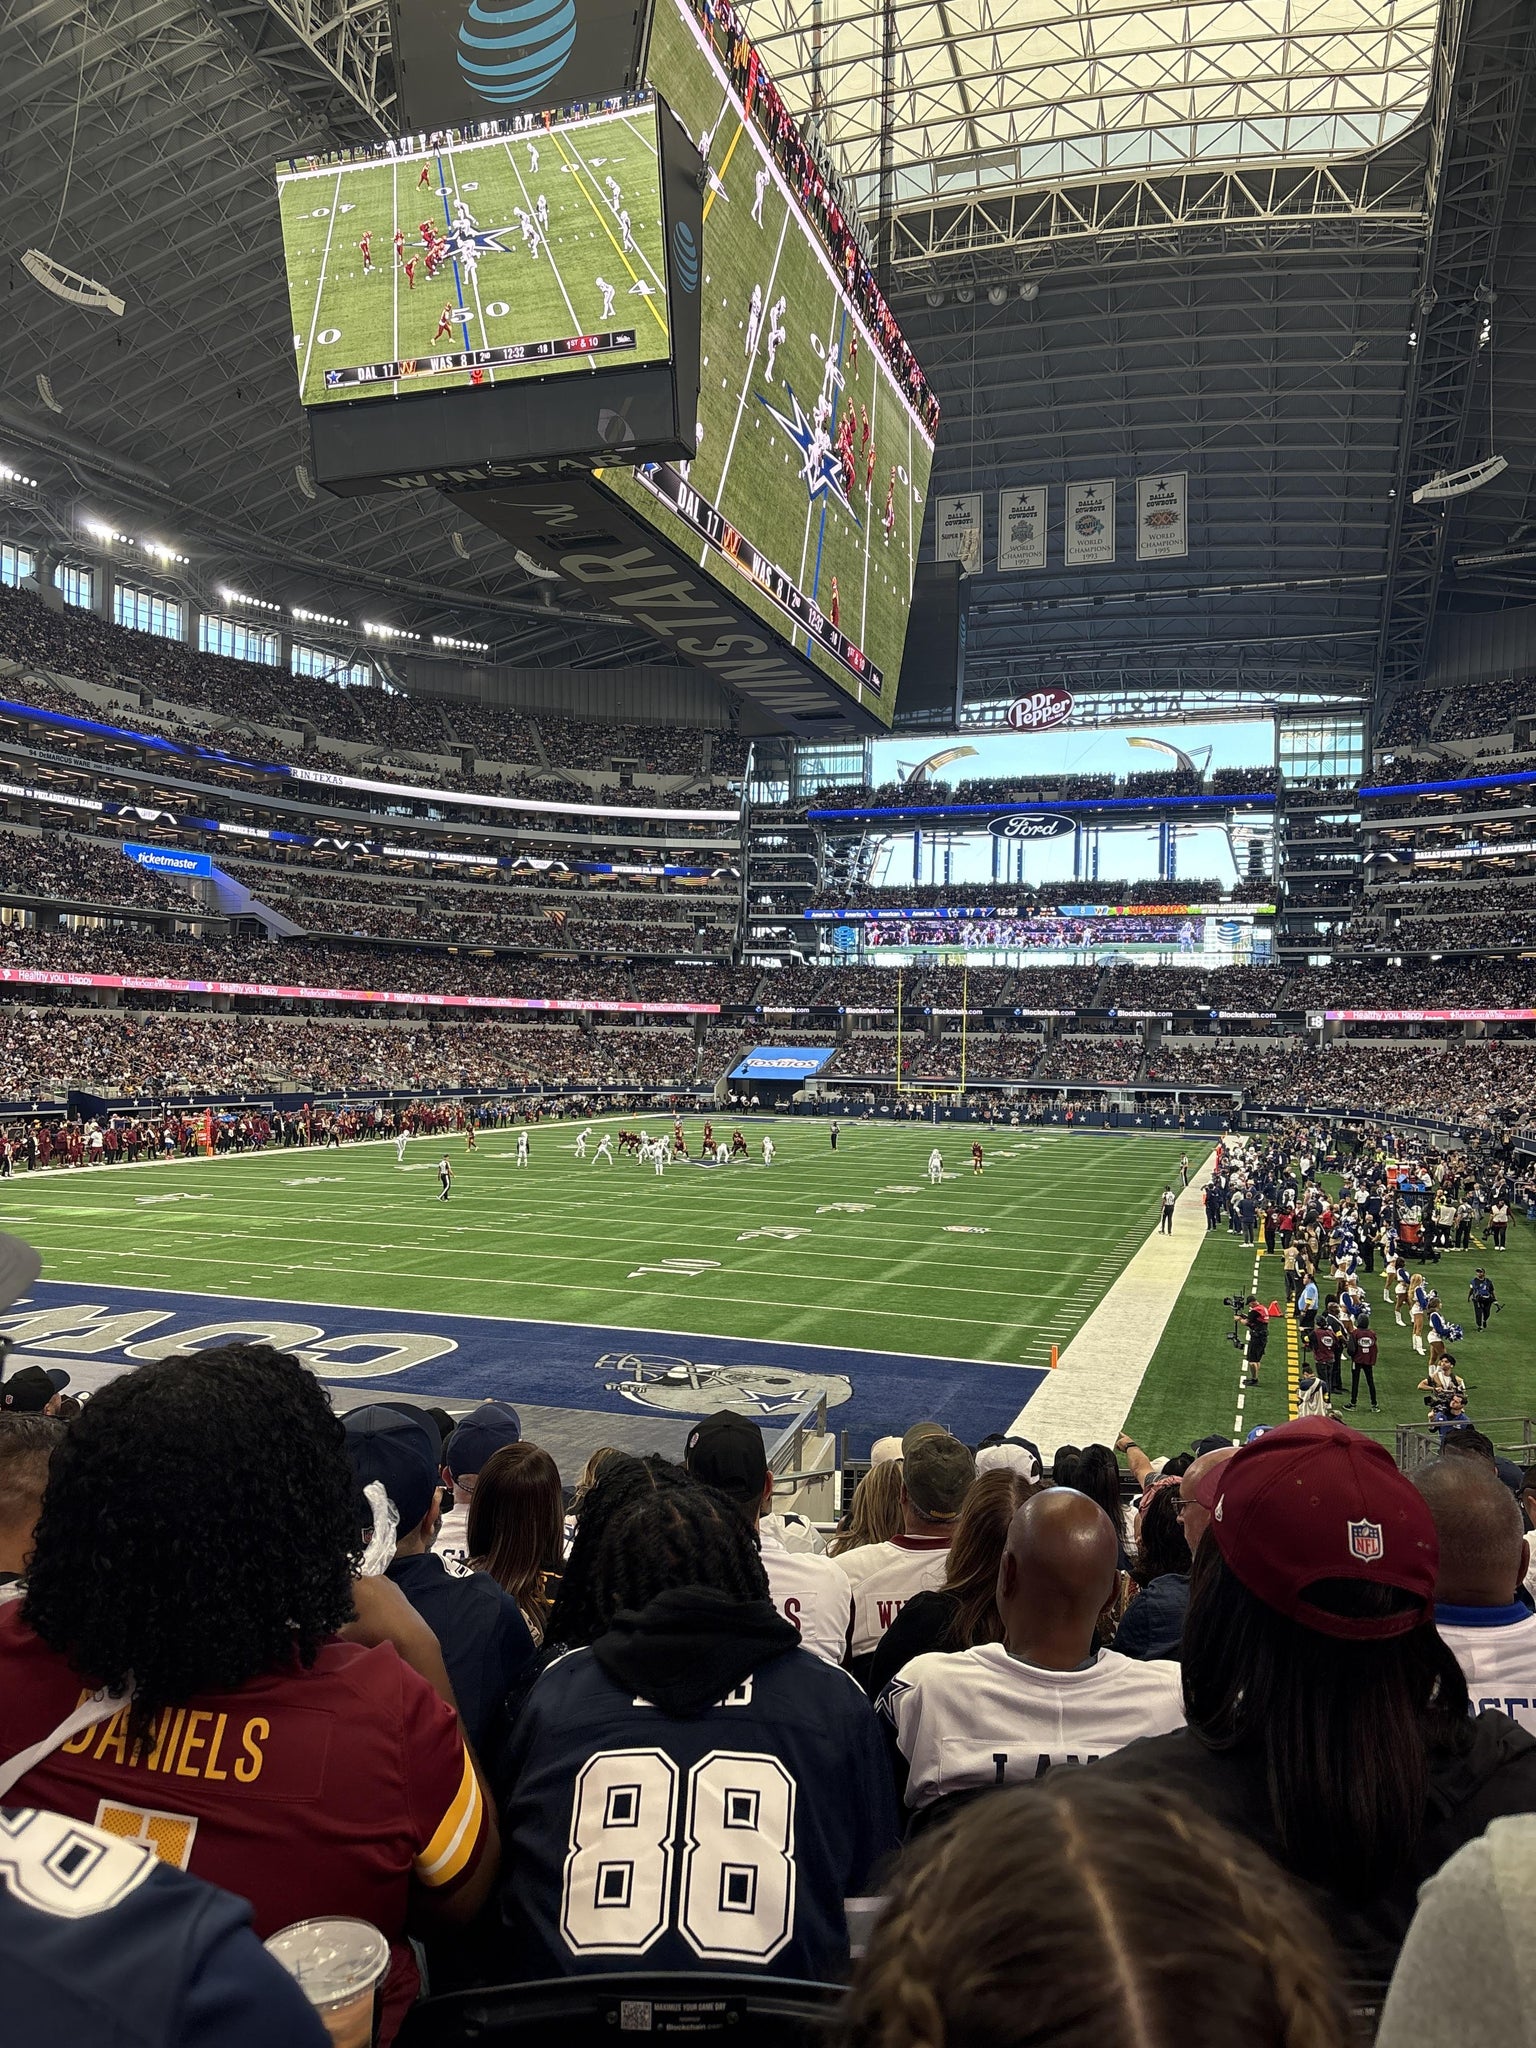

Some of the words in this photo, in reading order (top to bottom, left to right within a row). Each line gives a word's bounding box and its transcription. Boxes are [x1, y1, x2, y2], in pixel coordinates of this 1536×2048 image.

[357, 366, 377, 381] DAL
[382, 364, 394, 377] 17
[430, 355, 453, 369] WAS
[460, 354, 468, 367] 8
[503, 346, 525, 360] 12:32
[566, 339, 578, 350] 1ST
[580, 339, 587, 349] &
[588, 337, 599, 348] 10
[381, 453, 631, 490] WINSTAR
[1149, 492, 1175, 501] DALLAS
[1078, 499, 1103, 507] DALLAS
[1146, 498, 1178, 508] COWBOYS
[1075, 505, 1106, 514] COWBOYS
[947, 511, 971, 519] DALLAS
[1008, 511, 1038, 520] COWBOYS
[944, 518, 973, 527] COWBOYS
[1148, 532, 1176, 540] WORLD
[1009, 544, 1035, 552] WORLD
[1140, 538, 1184, 549] CHAMPIONS
[1069, 545, 1111, 554] CHAMPIONS
[676, 481, 700, 523] DAL
[706, 510, 719, 539] 17
[752, 552, 772, 588] WAS
[776, 577, 784, 599] 8
[808, 607, 824, 634] 12:32
[1001, 551, 1043, 560] CHAMPIONS
[559, 547, 842, 714] WINSTAR
[1031, 693, 1056, 712] Dr
[1015, 698, 1070, 728] Pepper
[73, 759, 91, 768] WARE
[300, 770, 311, 780] IN
[312, 772, 343, 785] TEXAS
[1004, 816, 1059, 836] Ford
[1415, 850, 1441, 860] DALLAS
[1441, 848, 1473, 859] COWBOYS
[1481, 843, 1532, 856] PHILADELPHIA
[137, 851, 198, 870] ticketmaster
[965, 908, 975, 916] 17
[996, 908, 1018, 916] 12:32
[1128, 904, 1188, 915] SUPERSCAPES
[18, 970, 48, 983] Healthy
[69, 975, 93, 986] Happy
[763, 1006, 810, 1014] Blockchain.com
[1117, 1010, 1173, 1018] Blockchain.com
[1219, 1011, 1277, 1019] Blockchain.com
[1353, 1010, 1382, 1020] Healthy
[1402, 1010, 1424, 1020] Happy
[626, 1258, 722, 1278] 10
[1355, 1538, 1378, 1554] NFL
[559, 1747, 797, 1965] 88
